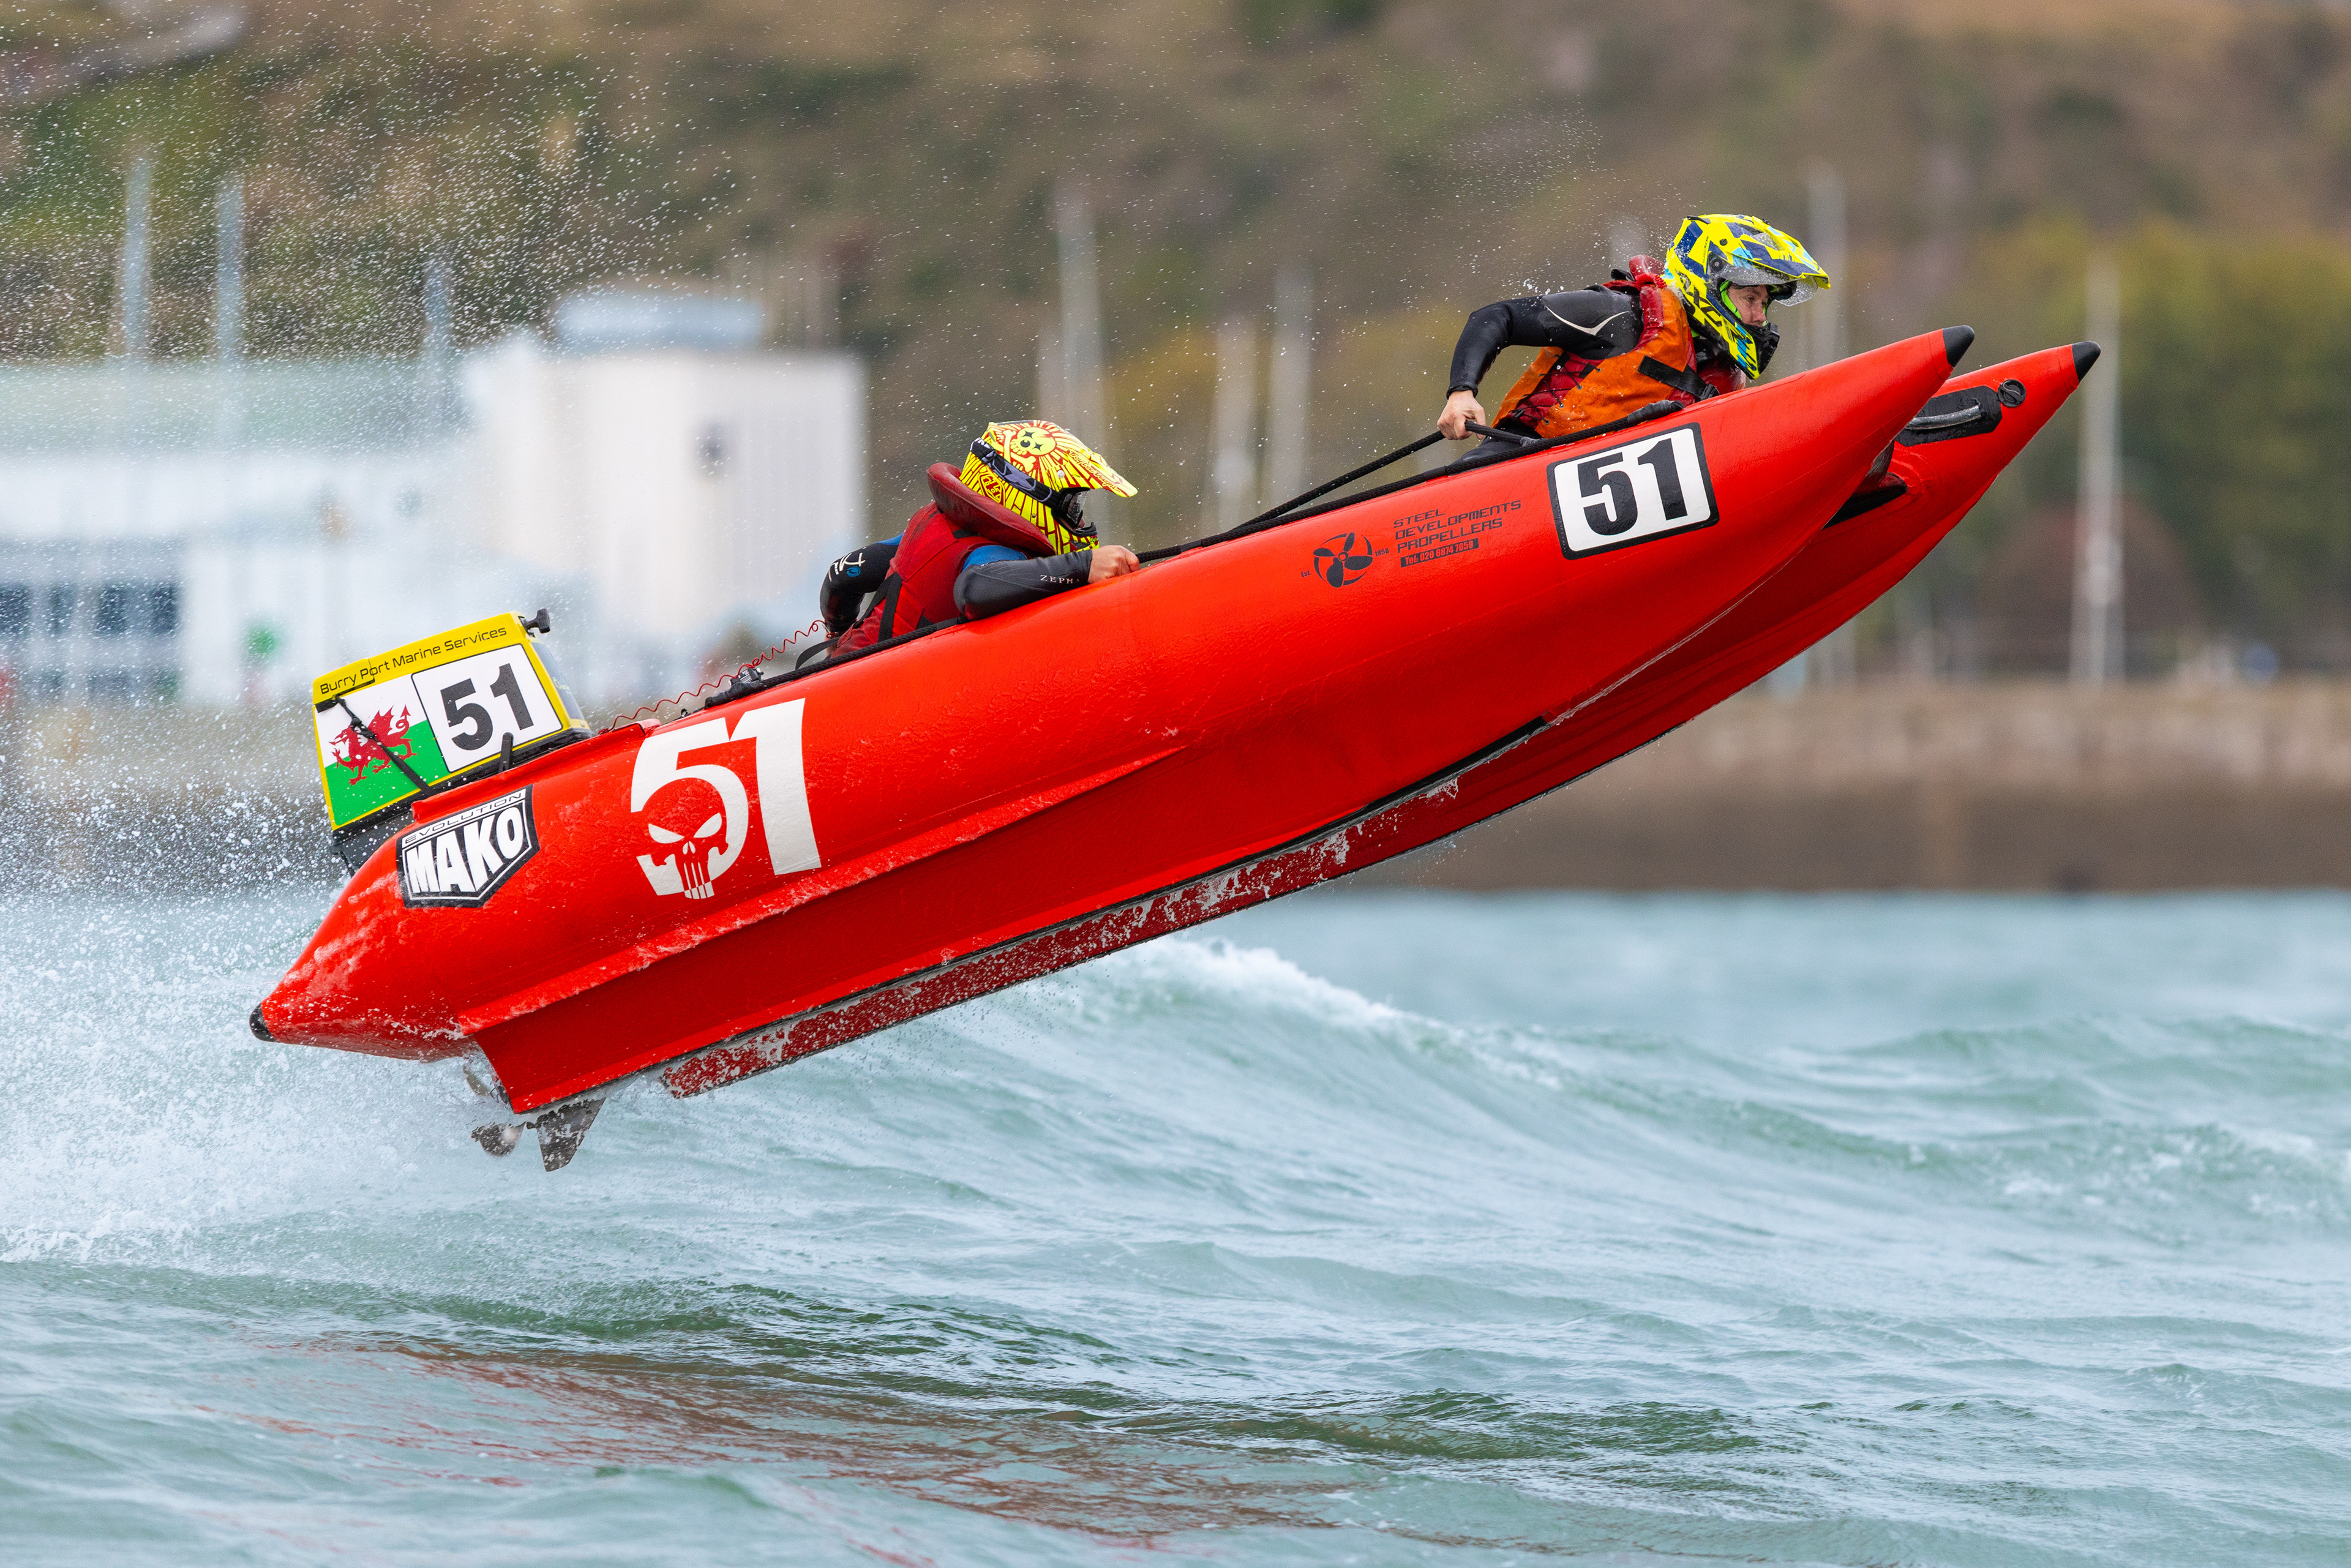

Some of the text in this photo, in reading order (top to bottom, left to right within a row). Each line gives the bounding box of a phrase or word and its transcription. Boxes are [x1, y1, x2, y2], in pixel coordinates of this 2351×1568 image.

[1577, 438, 1688, 536] 51
[1393, 509, 1445, 528] STEEL
[1395, 500, 1521, 540] DEVELOPMENTS
[1397, 518, 1502, 553] PROPELLERS
[1374, 547, 1390, 557] 1958
[1420, 550, 1434, 561] 020
[1455, 540, 1474, 553] 7059
[1040, 574, 1079, 584] ZEPH
[320, 628, 507, 694] Burry Port Marine Services
[440, 662, 534, 751] 51
[405, 792, 522, 844] EVOLUTION
[631, 697, 822, 899] 51
[406, 807, 523, 893] MAKO
